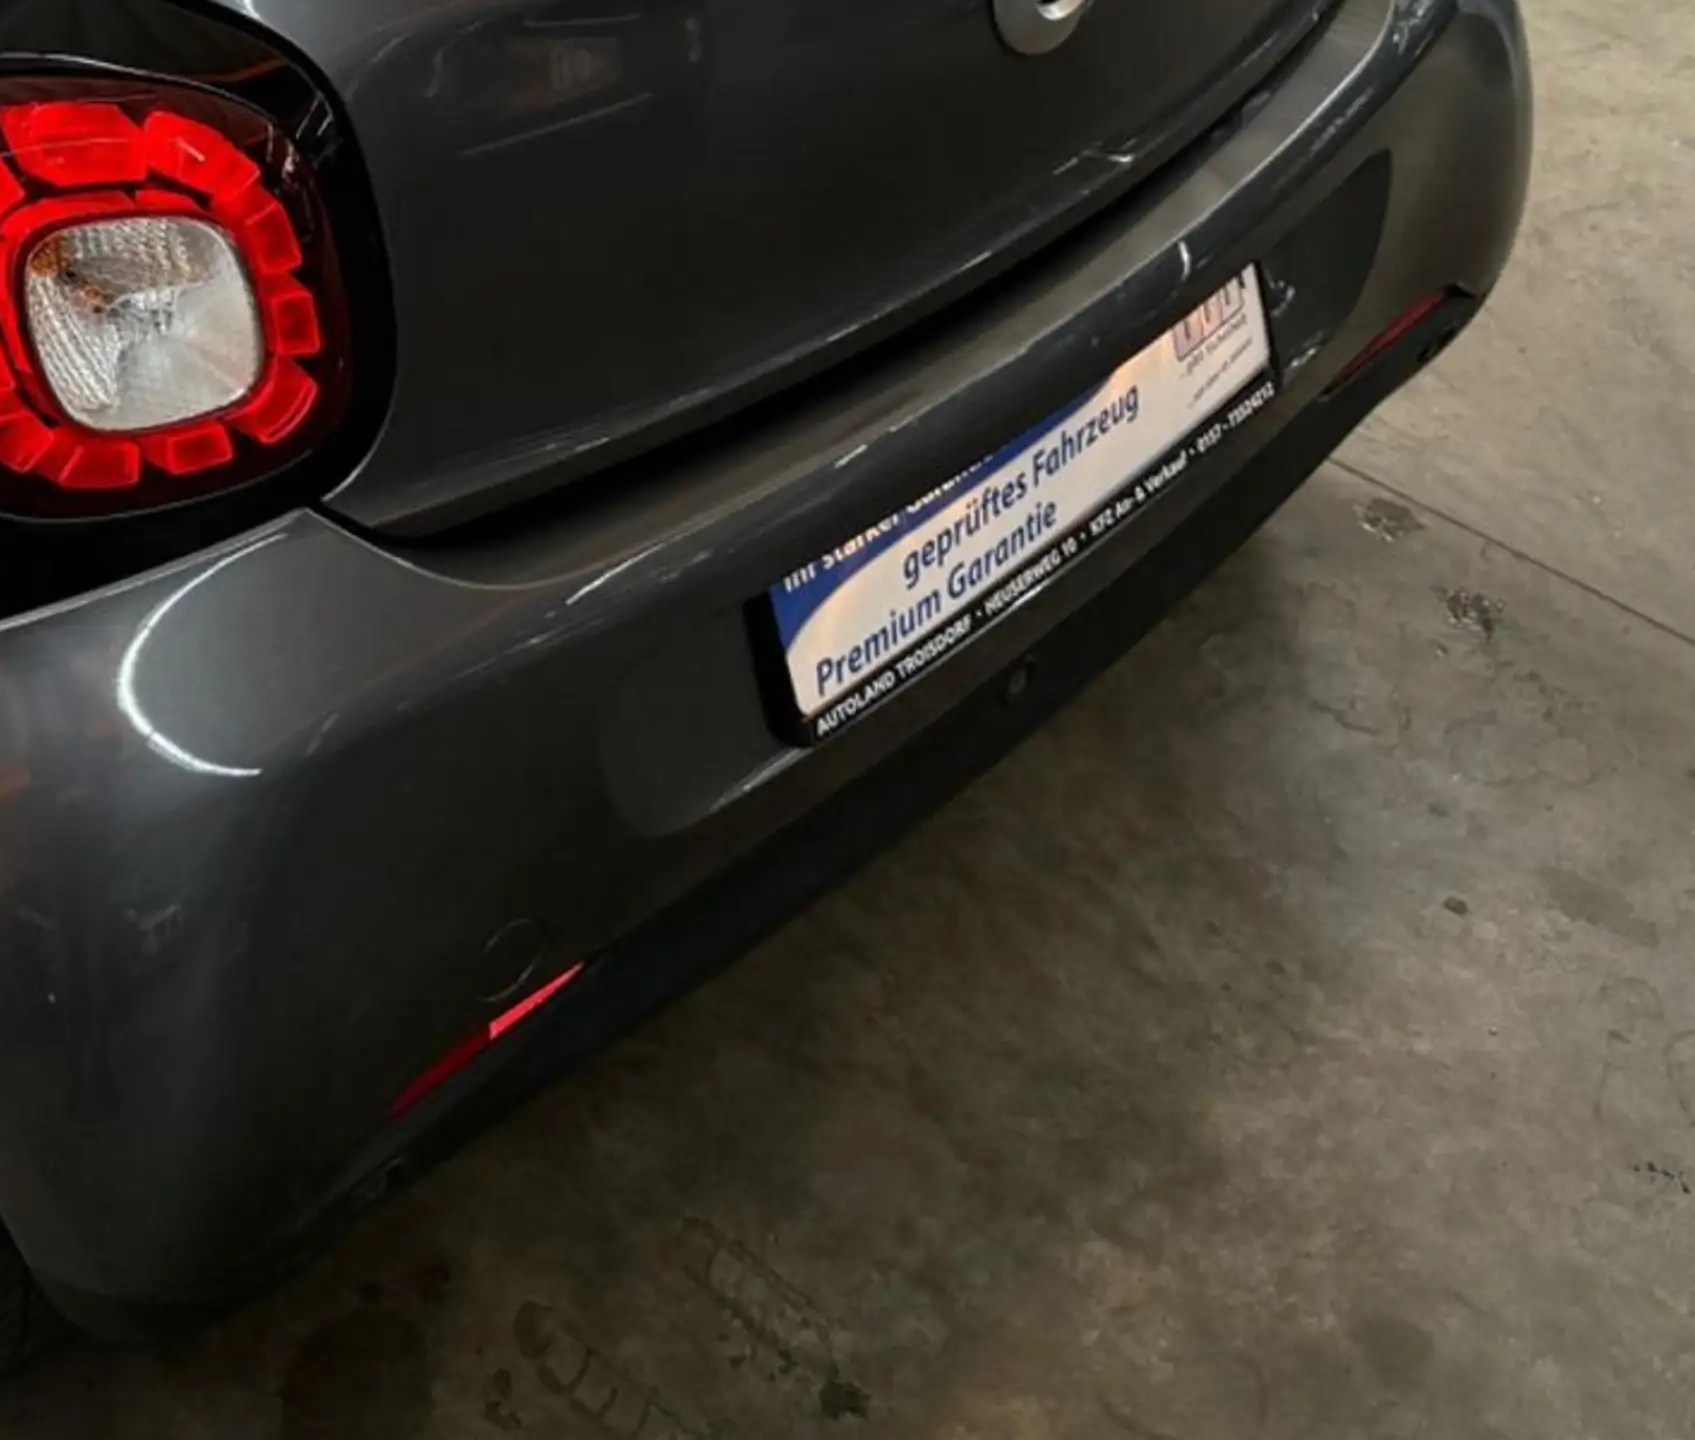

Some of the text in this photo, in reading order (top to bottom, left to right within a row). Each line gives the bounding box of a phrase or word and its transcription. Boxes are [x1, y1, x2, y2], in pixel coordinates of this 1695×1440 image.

[902, 471, 1027, 591] geprüftes
[1032, 384, 1140, 488] Fahrzeug
[815, 501, 1058, 697] Premium Garantie
[816, 669, 896, 736] AUTOLAND
[895, 613, 972, 679] TROISDORF
[1144, 449, 1189, 492] Verkauf
